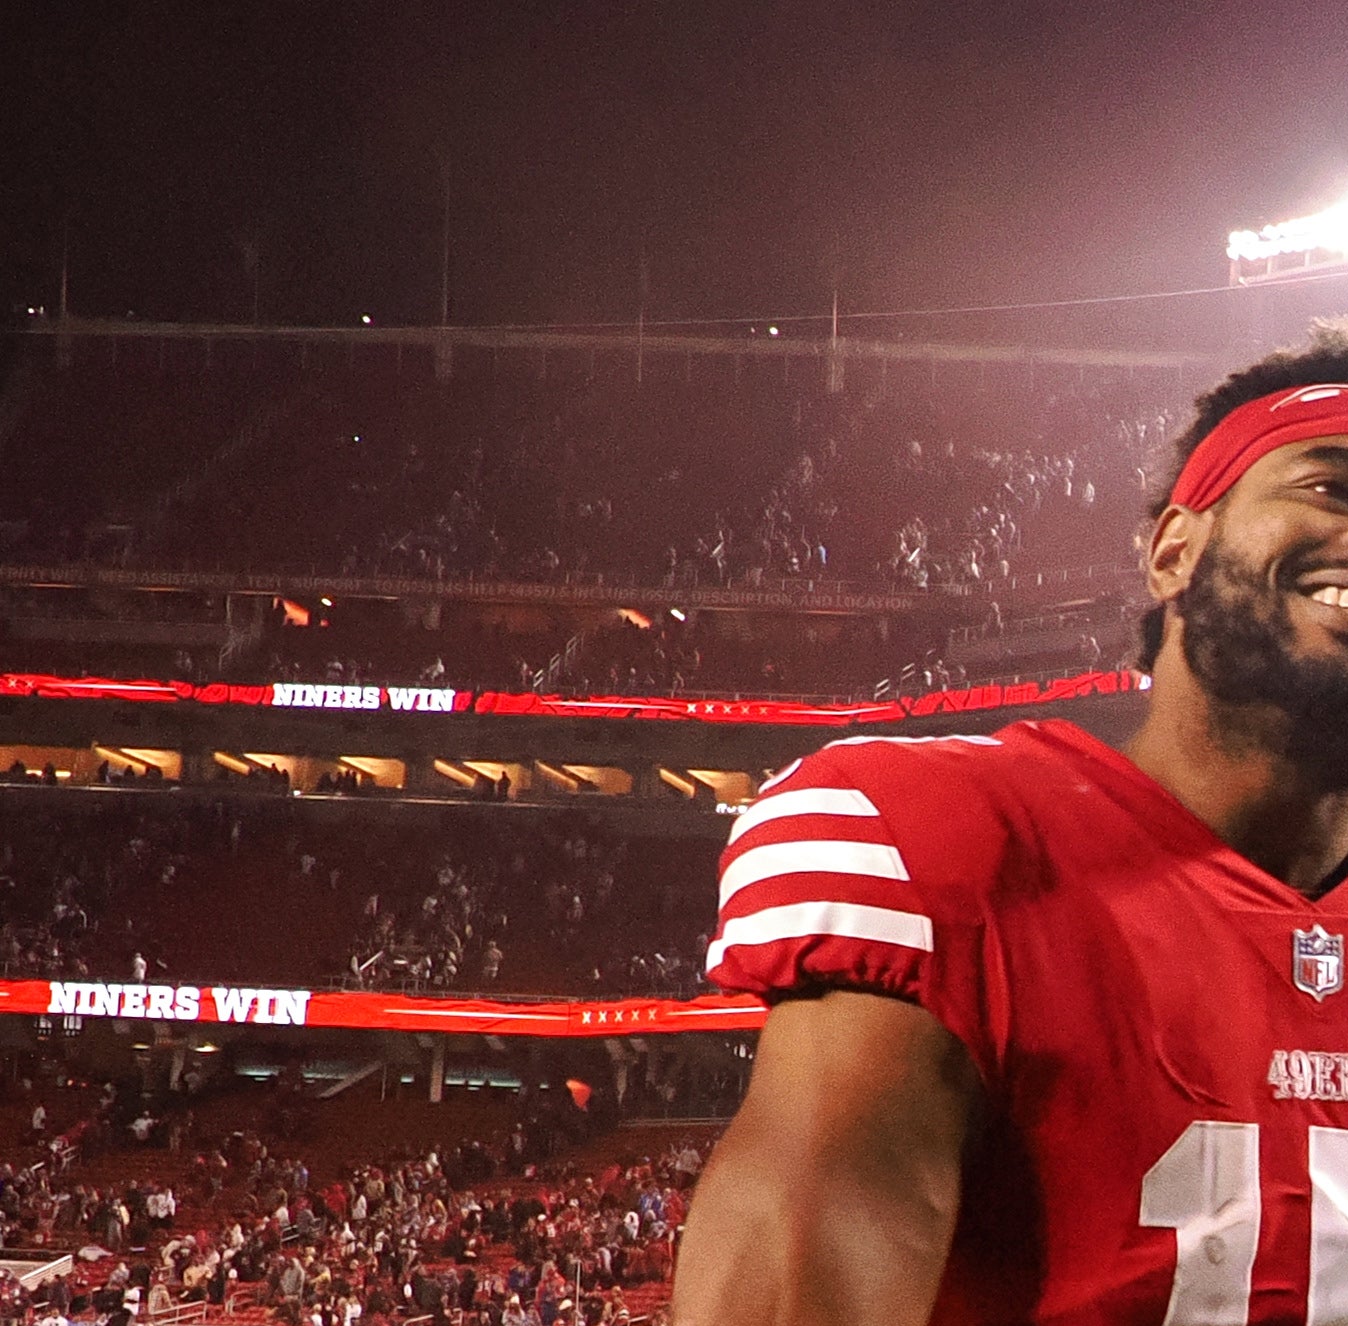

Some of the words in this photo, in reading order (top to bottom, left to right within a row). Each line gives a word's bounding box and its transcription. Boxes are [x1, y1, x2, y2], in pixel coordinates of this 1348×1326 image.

[272, 683, 380, 710] NINERS
[388, 687, 456, 712] WIN
[1301, 956, 1336, 988] NFL
[48, 983, 200, 1021] NINERS
[212, 987, 311, 1025] WIN
